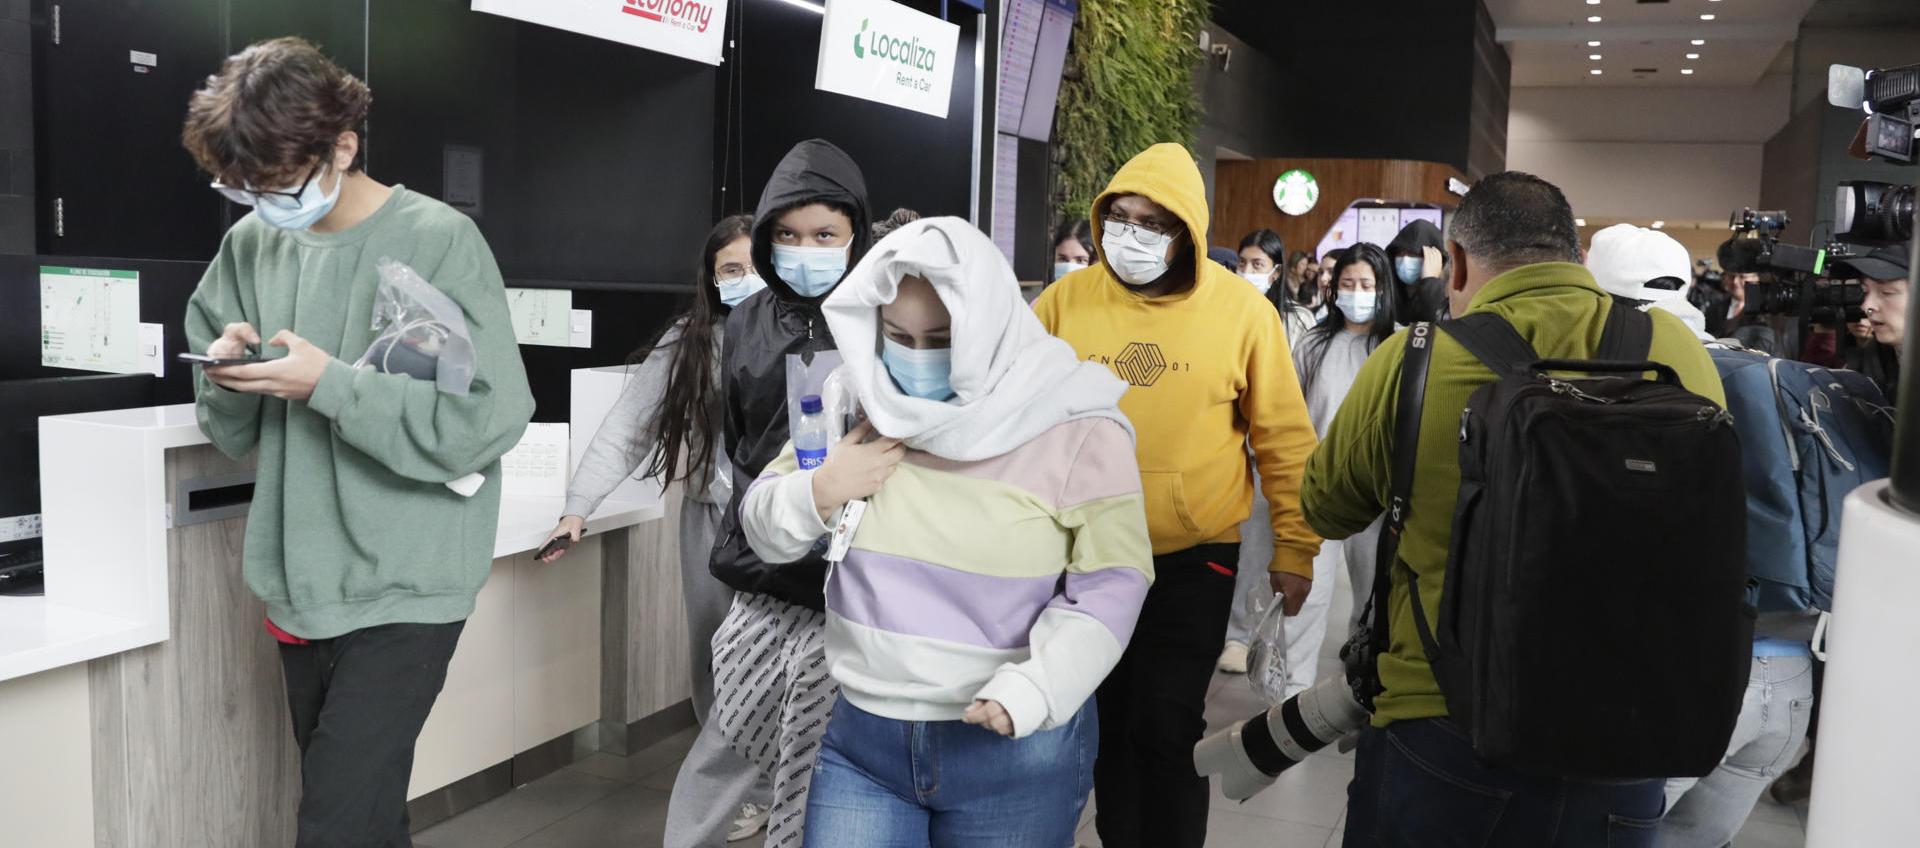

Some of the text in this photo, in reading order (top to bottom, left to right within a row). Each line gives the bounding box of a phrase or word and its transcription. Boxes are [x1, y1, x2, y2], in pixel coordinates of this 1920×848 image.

[626, 0, 712, 33] onomy
[896, 71, 932, 92] Rent a Car
[801, 456, 824, 467] CRIS
